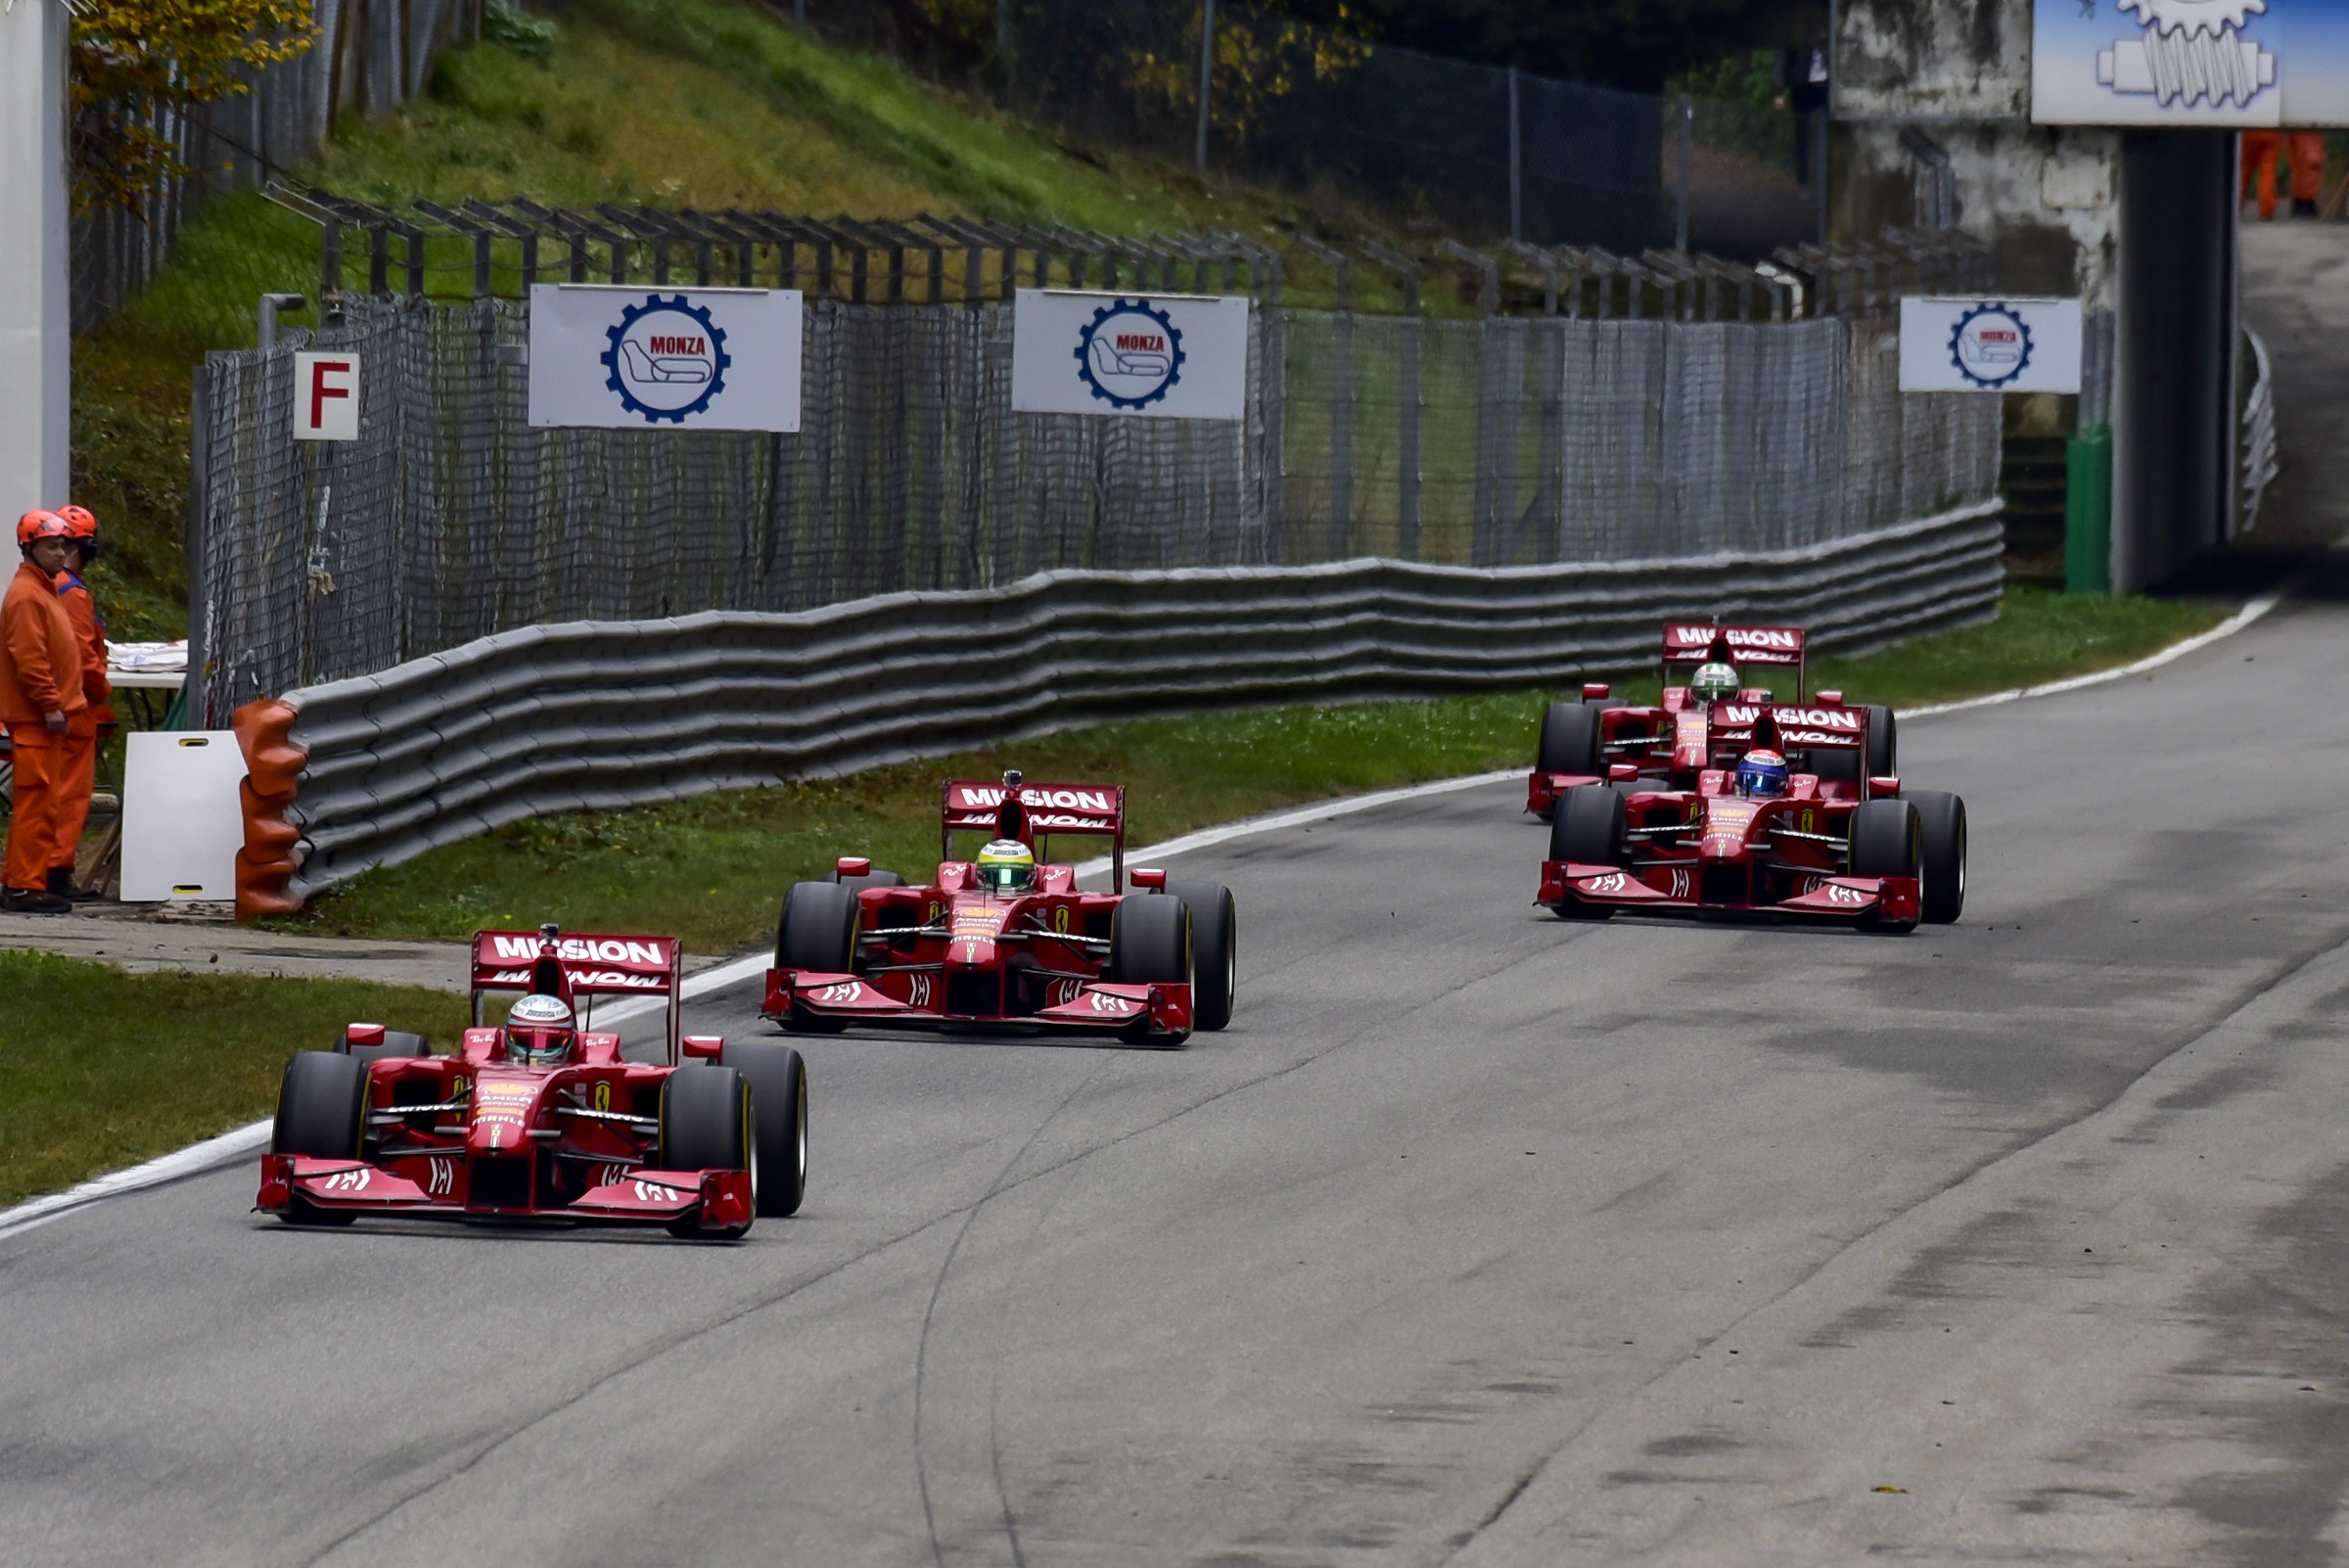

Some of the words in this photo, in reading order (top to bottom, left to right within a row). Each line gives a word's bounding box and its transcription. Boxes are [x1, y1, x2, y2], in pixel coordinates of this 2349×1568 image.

[650, 336, 706, 355] MONZA
[1116, 335, 1165, 351] MONZA
[310, 362, 350, 429] F
